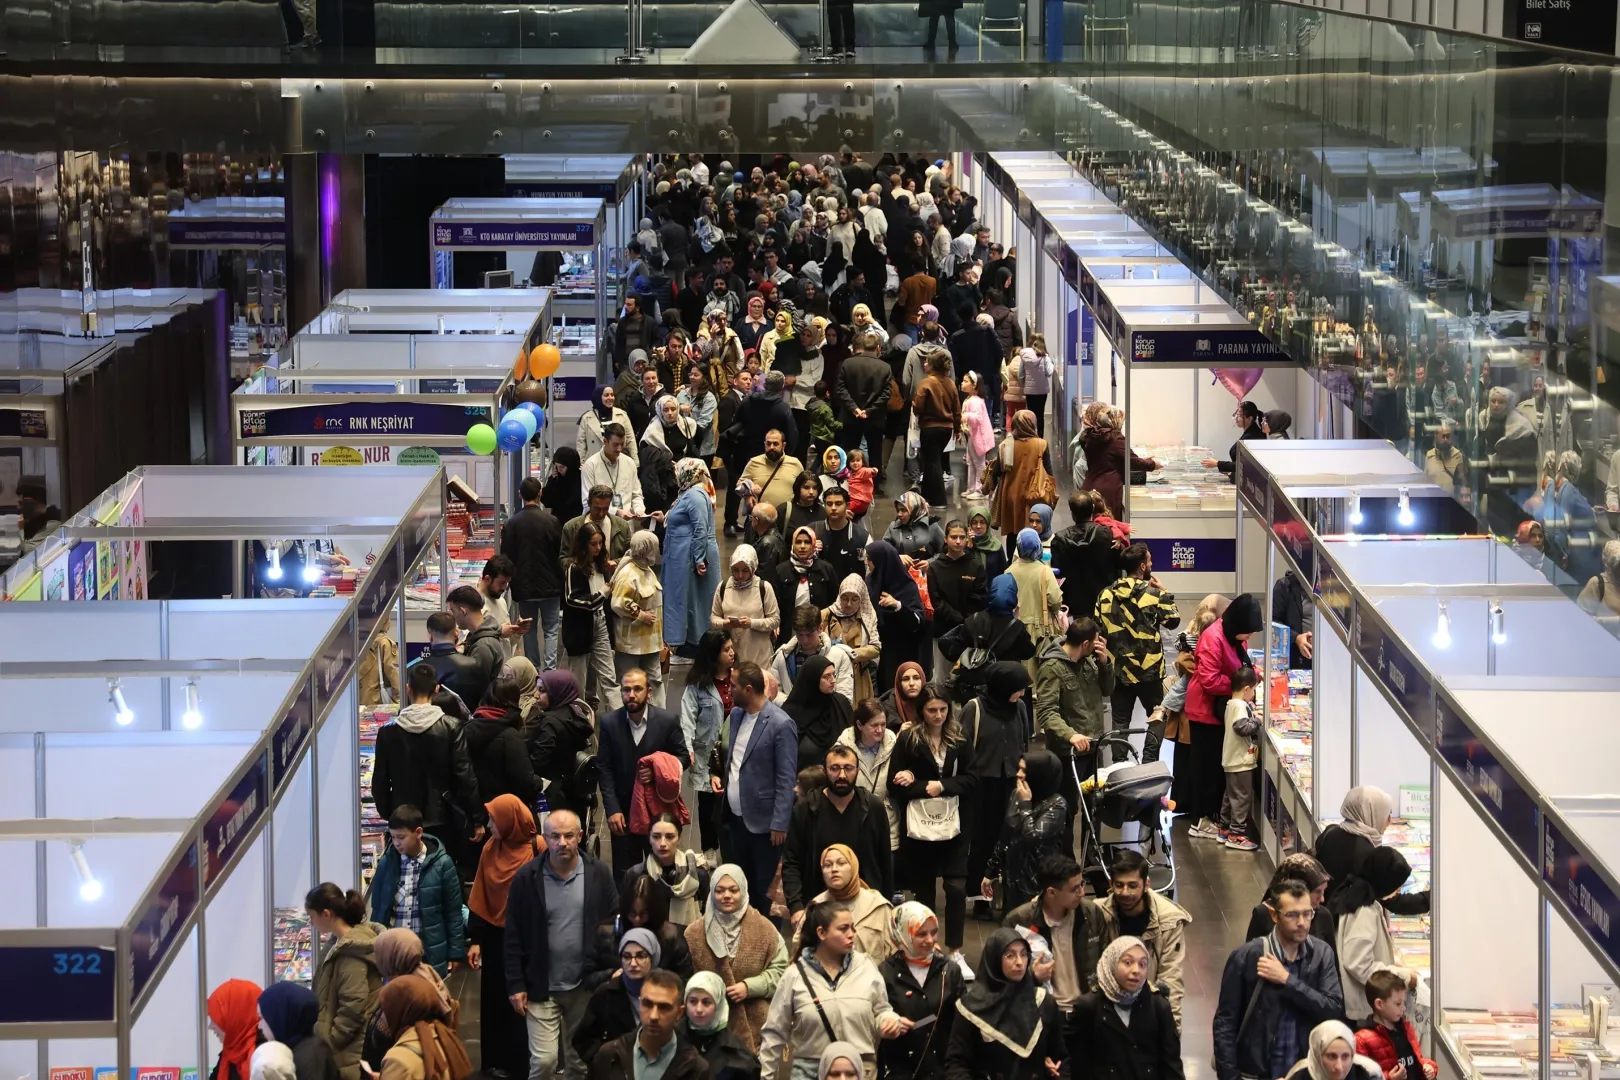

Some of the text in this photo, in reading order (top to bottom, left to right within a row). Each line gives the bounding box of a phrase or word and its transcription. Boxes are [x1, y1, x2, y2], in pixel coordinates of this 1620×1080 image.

[1526, 0, 1571, 10] Bilet Satış
[575, 224, 590, 232] 327
[480, 232, 491, 241] KTO
[491, 232, 514, 241] KARATAY
[515, 231, 549, 241] ÜNİVERSİTESİ
[550, 232, 577, 241] YAYINLARI
[1218, 343, 1249, 354] PARANA
[465, 406, 487, 416] 325
[349, 414, 414, 432] RNK NEŞRİYAT
[364, 446, 390, 464] NUR
[1172, 546, 1195, 554] konya
[53, 953, 101, 975] 322
